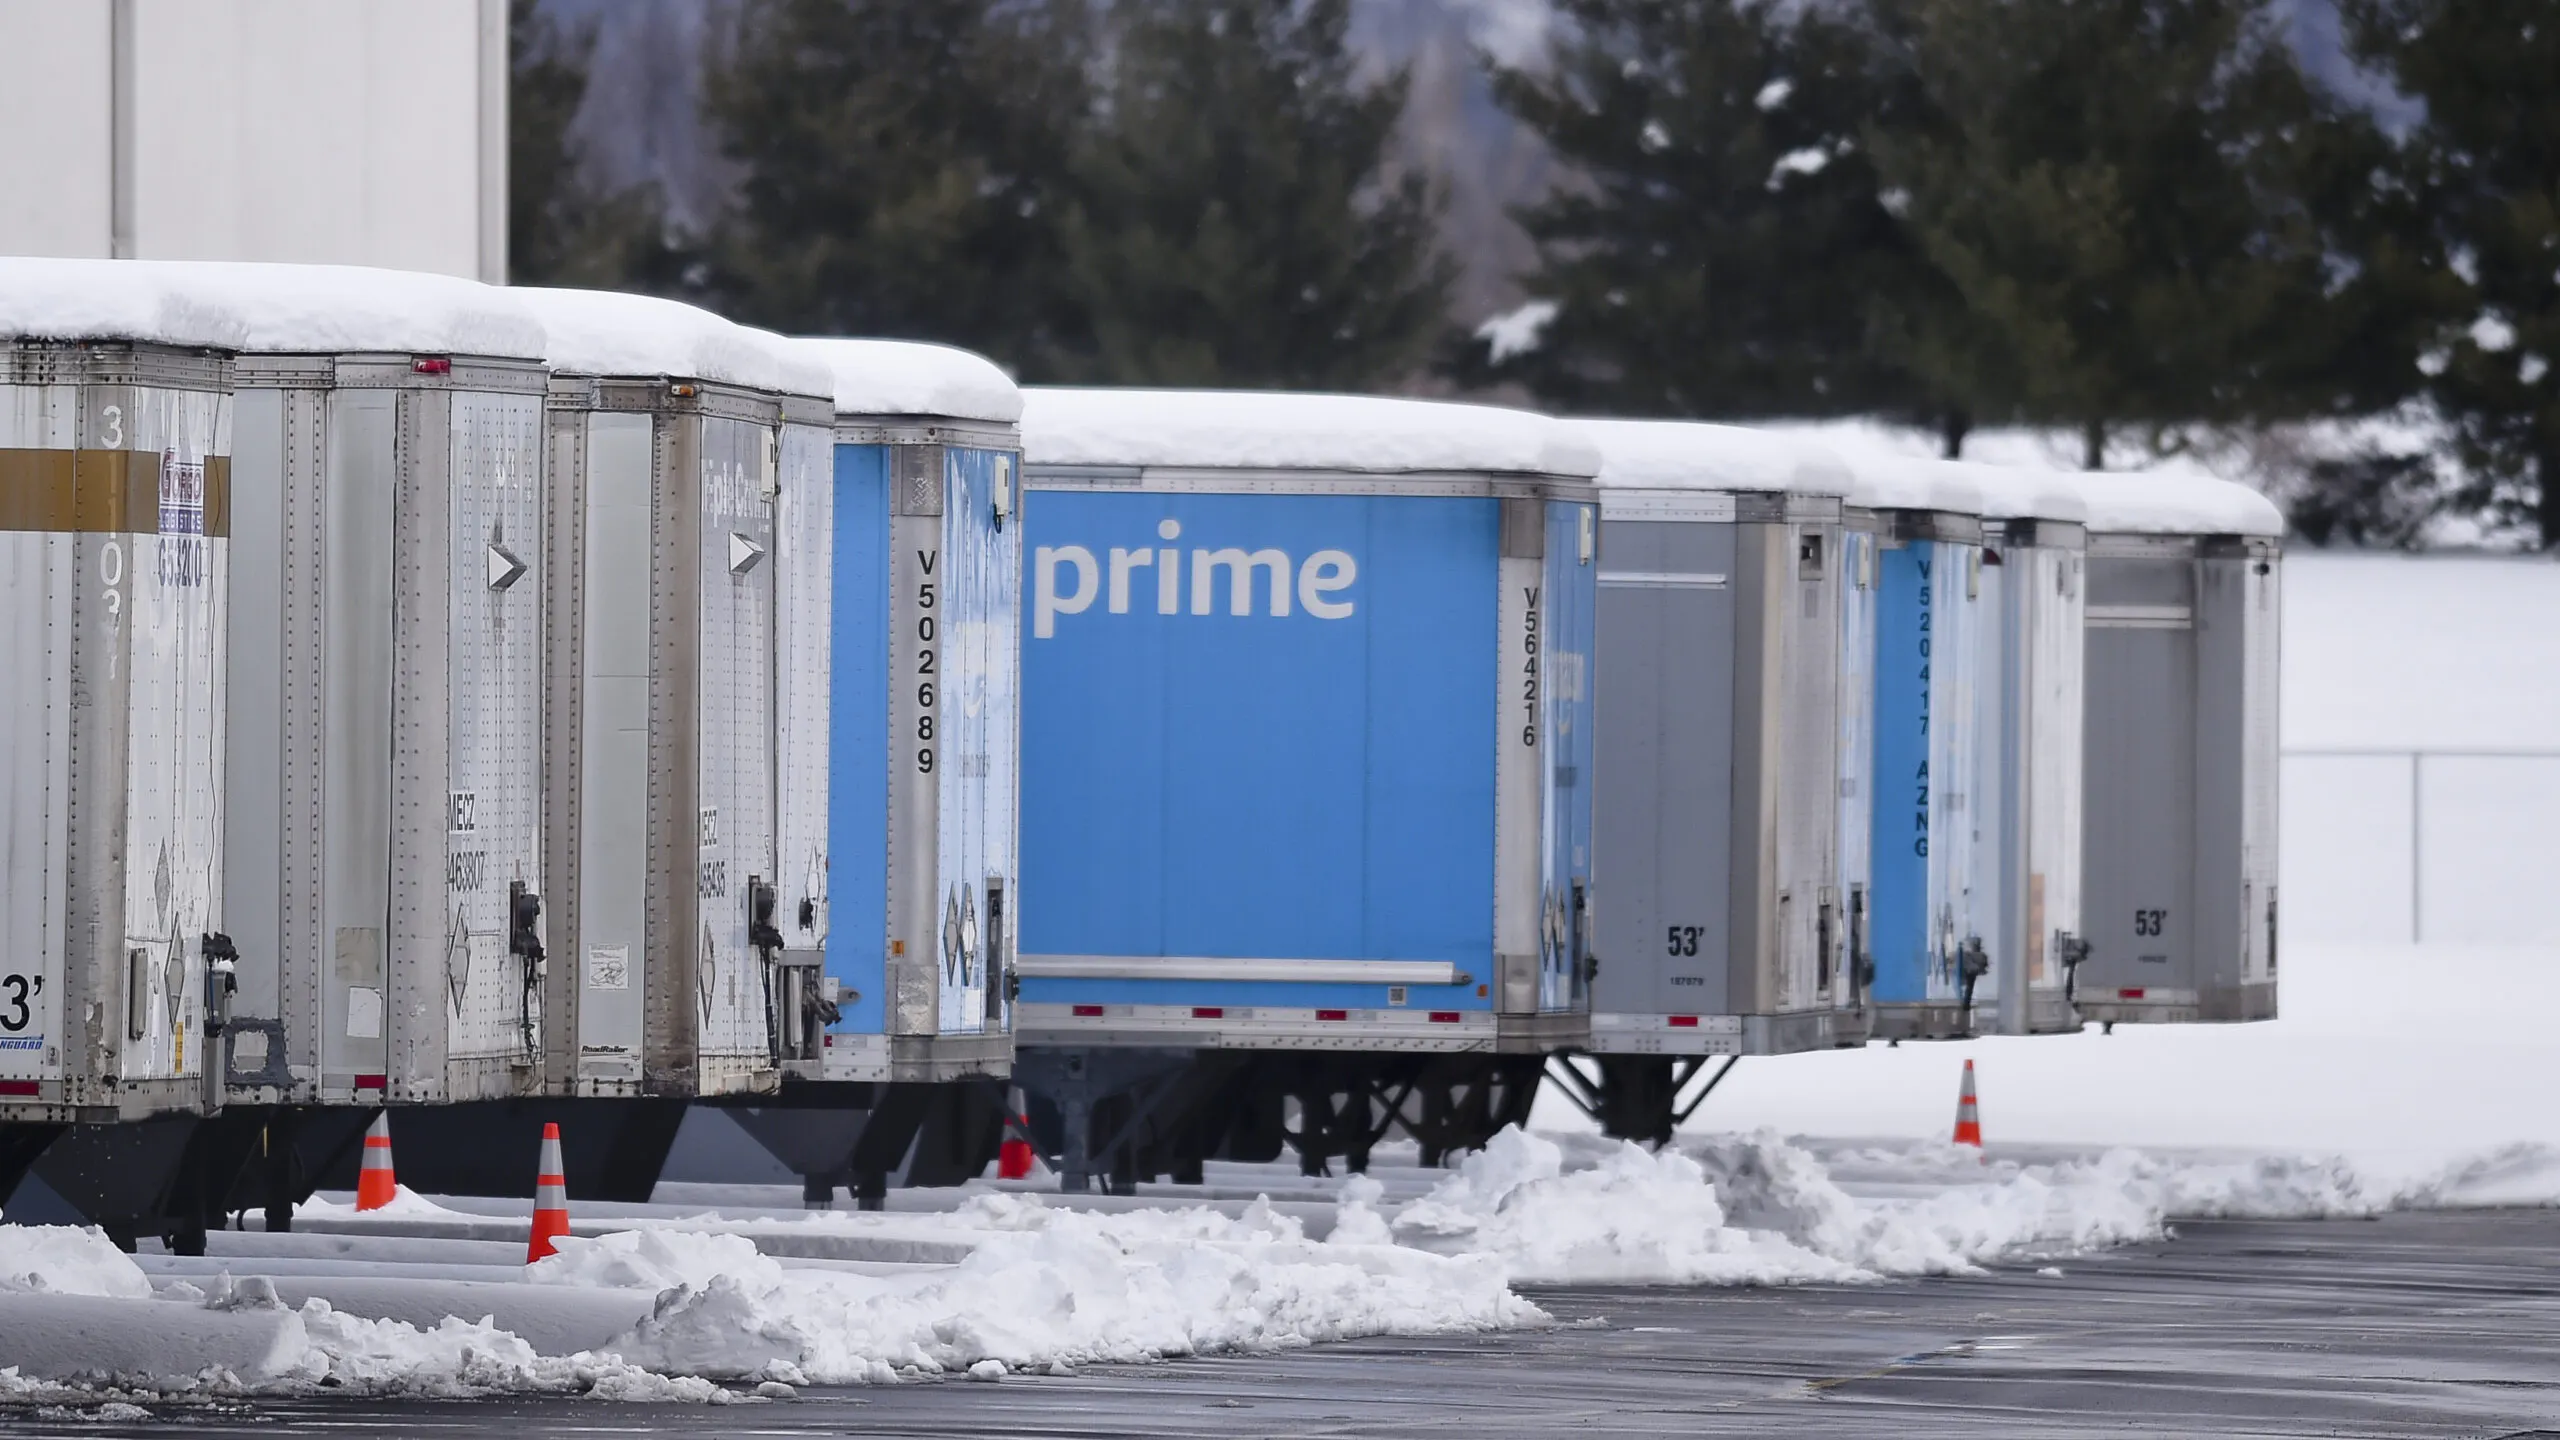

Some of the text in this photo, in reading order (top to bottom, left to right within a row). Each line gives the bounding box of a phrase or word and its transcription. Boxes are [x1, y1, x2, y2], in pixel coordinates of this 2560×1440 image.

[1034, 519, 1356, 639] prime
[917, 550, 936, 774] V502689
[1523, 588, 1538, 747] V564216
[1918, 560, 1931, 736] V520417
[448, 793, 475, 831] MECZ
[1667, 926, 1705, 958] 53'
[2135, 910, 2167, 937] 53'
